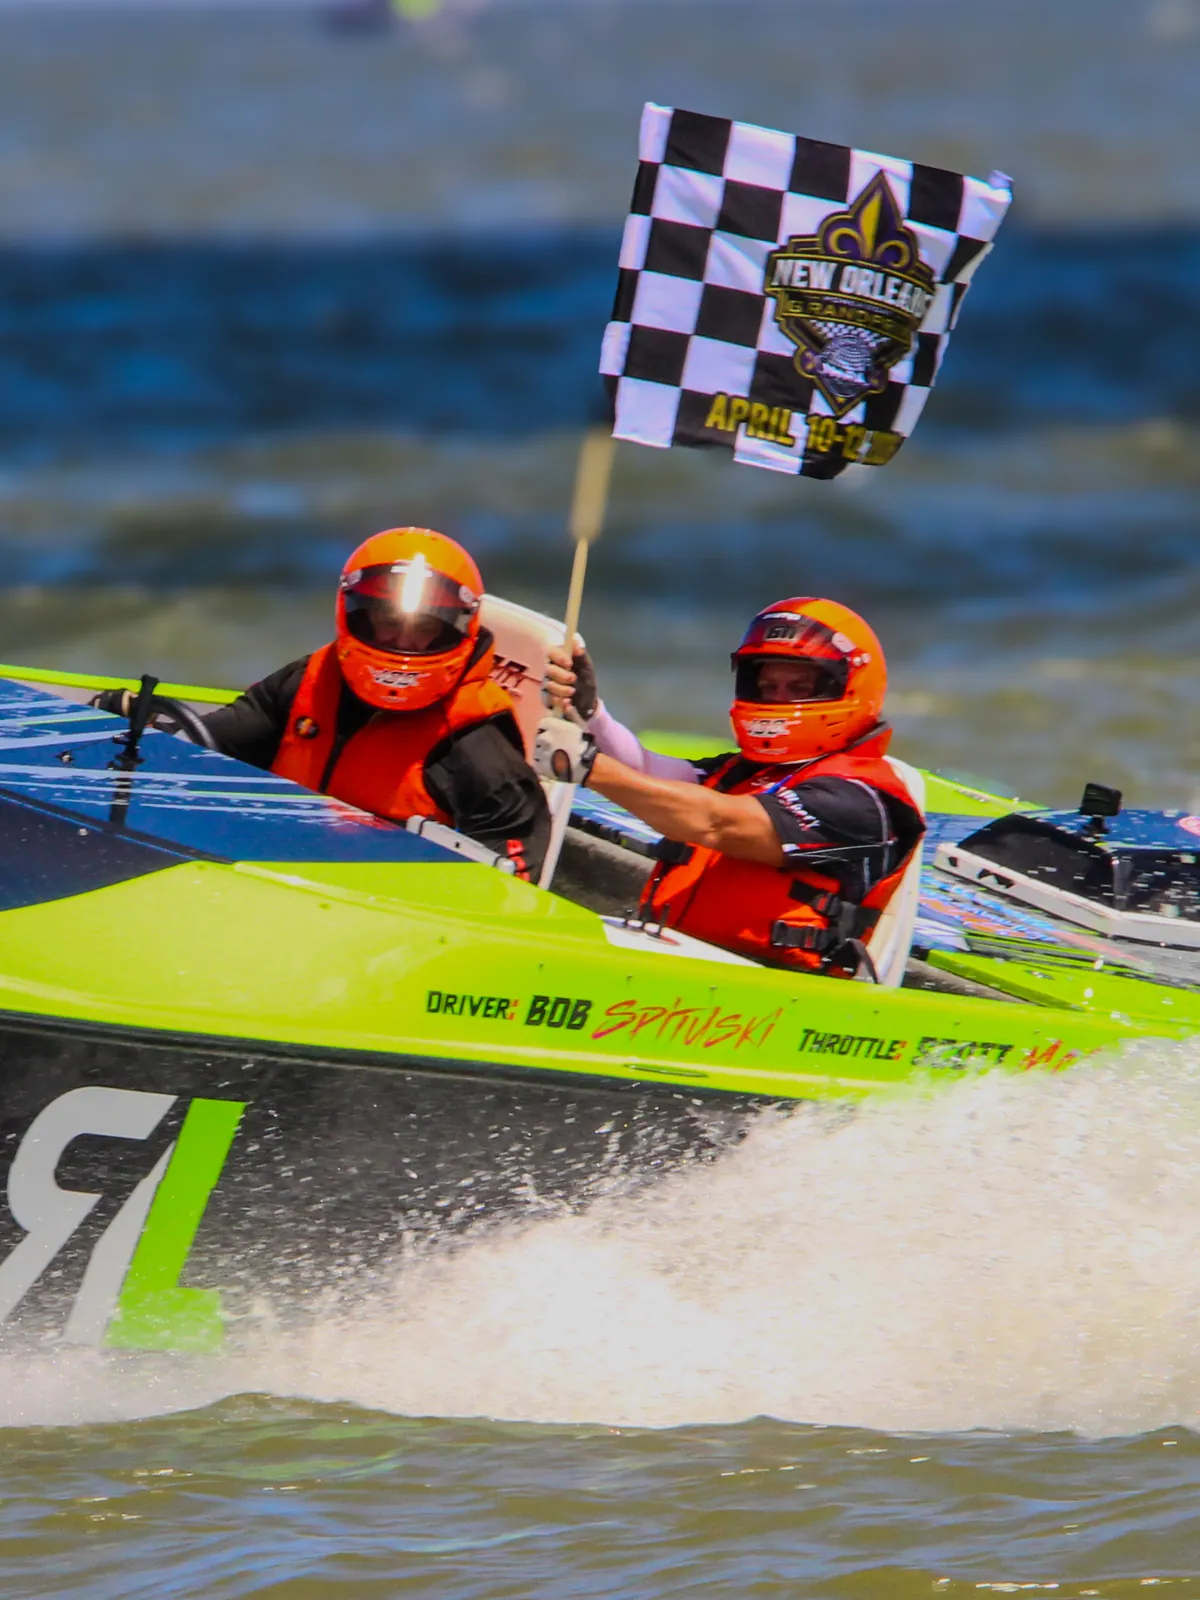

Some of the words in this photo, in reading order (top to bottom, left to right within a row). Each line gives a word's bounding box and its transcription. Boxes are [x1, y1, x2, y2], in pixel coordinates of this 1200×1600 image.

[771, 258, 837, 291] NEW
[704, 393, 796, 446] APRIL
[426, 990, 519, 1021] DRIVER:
[524, 995, 592, 1030] BOB
[799, 1028, 907, 1061] THROTTLE:
